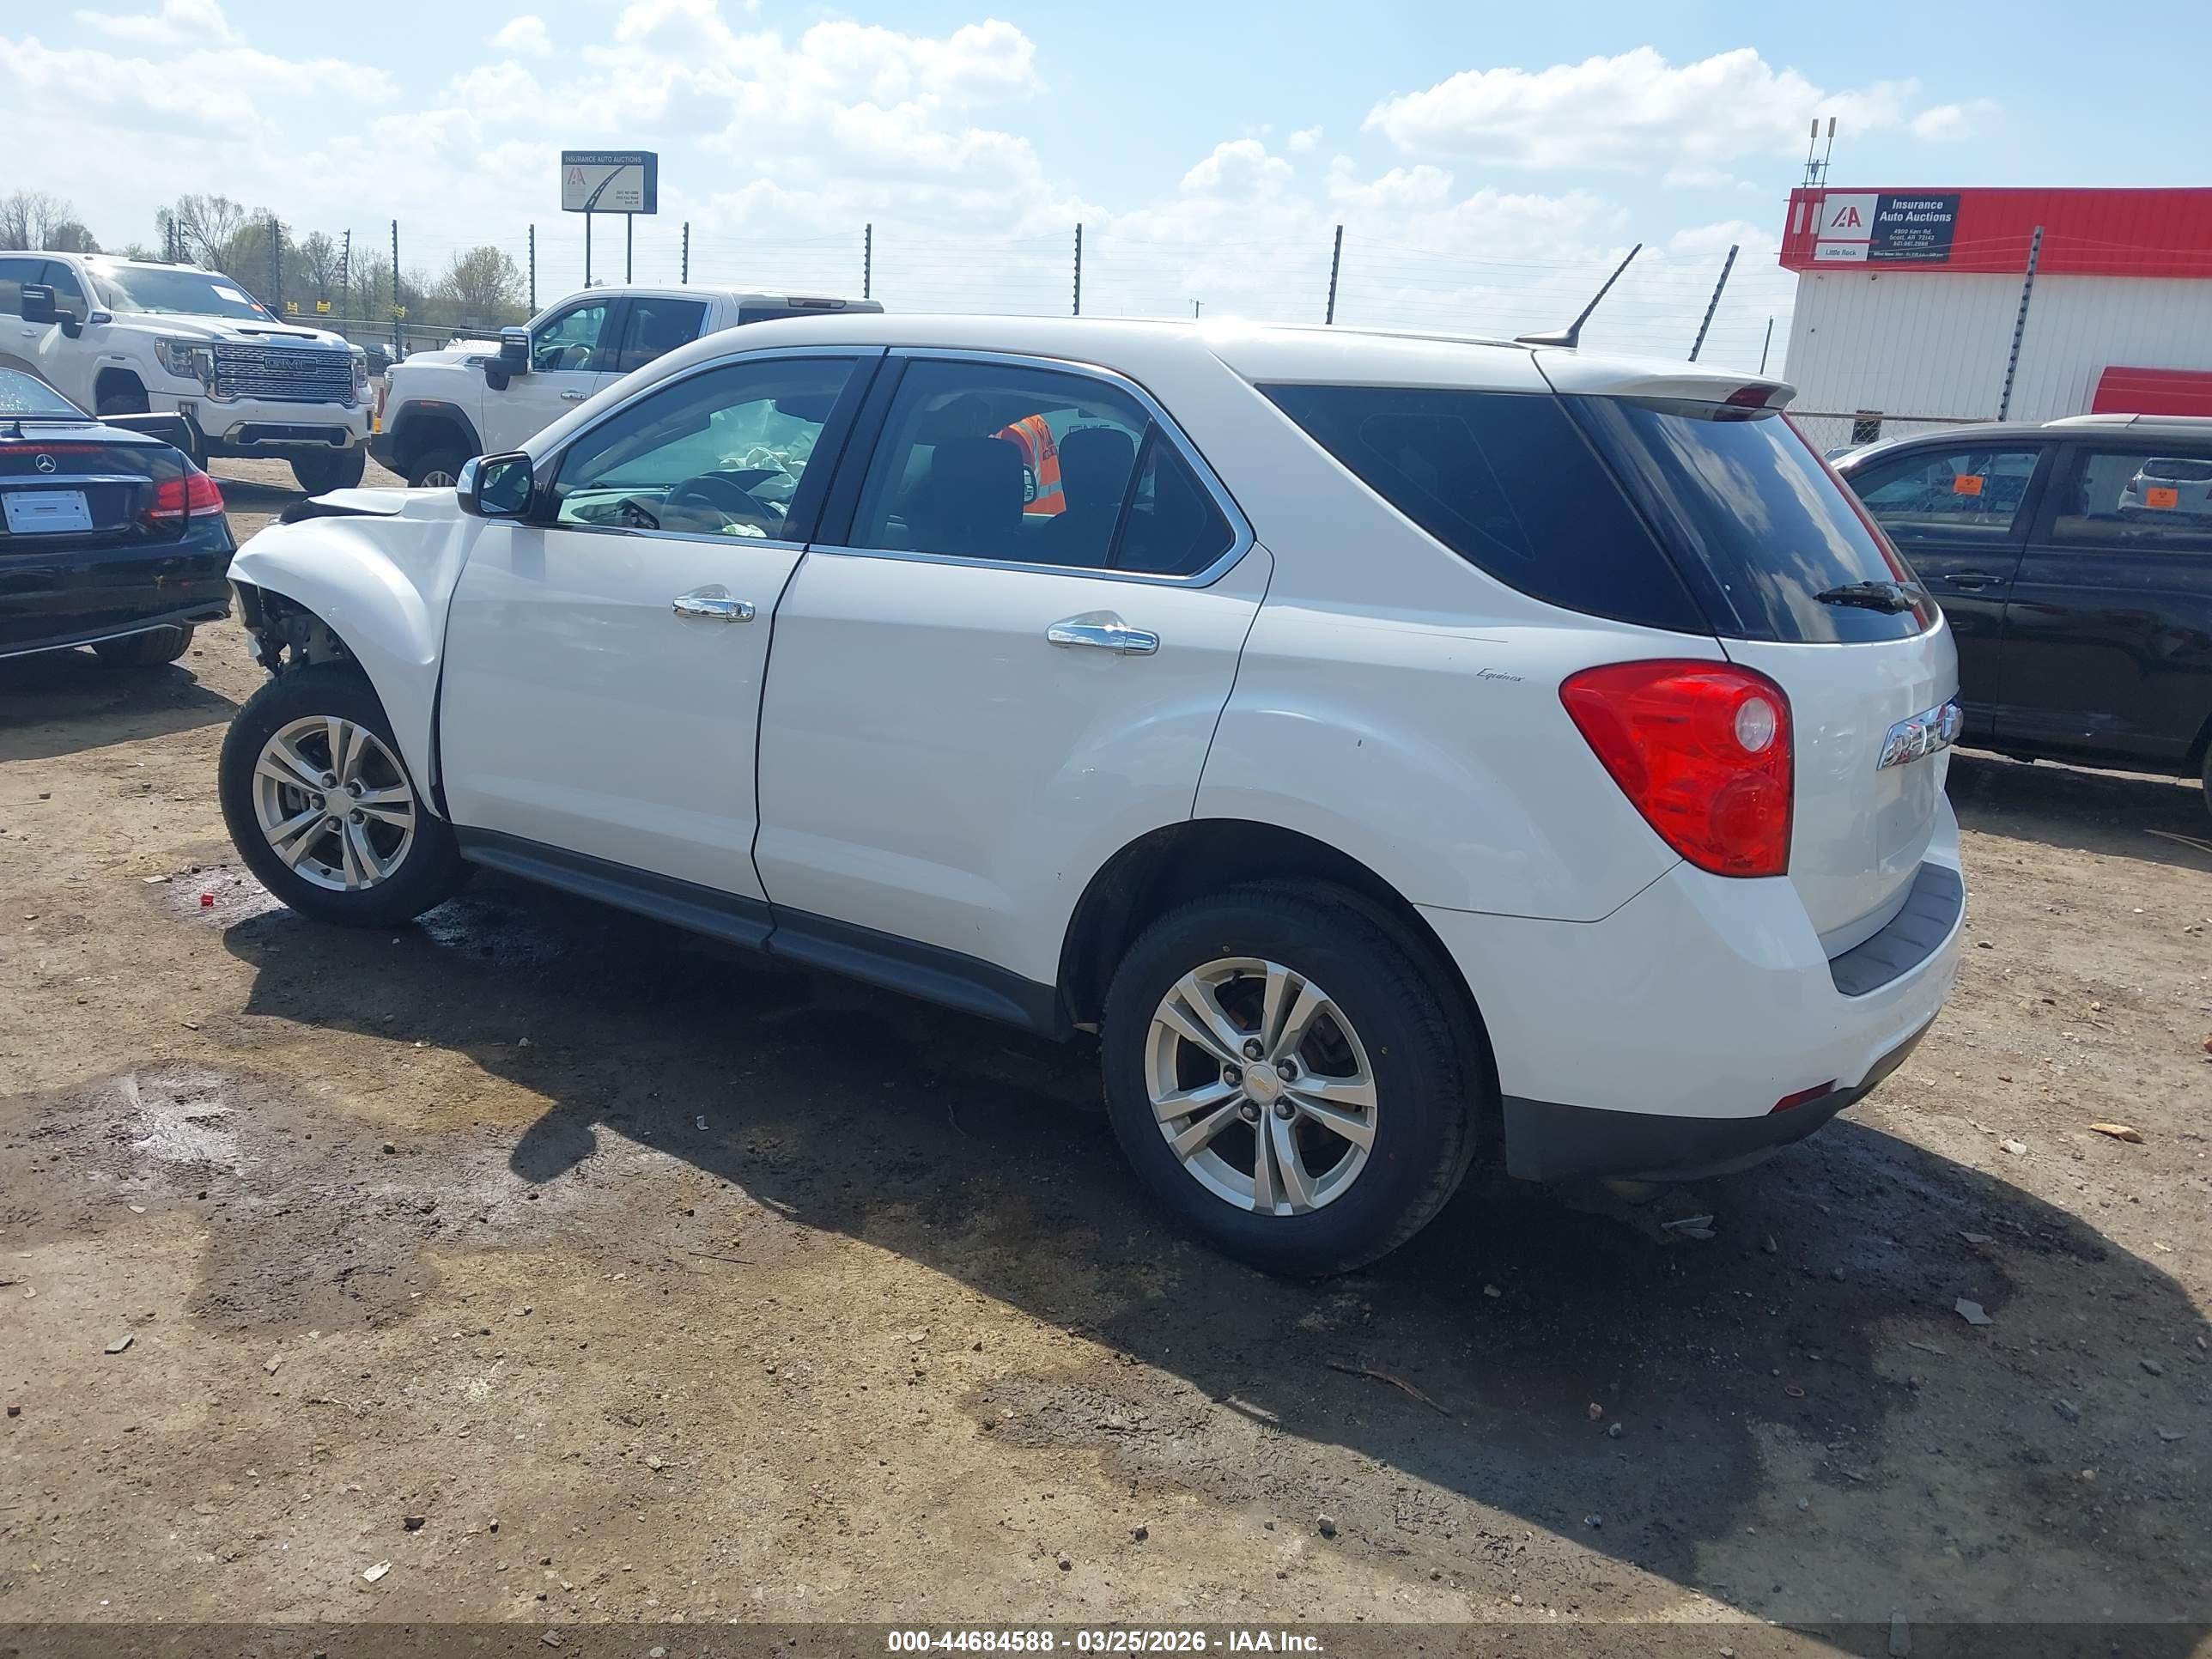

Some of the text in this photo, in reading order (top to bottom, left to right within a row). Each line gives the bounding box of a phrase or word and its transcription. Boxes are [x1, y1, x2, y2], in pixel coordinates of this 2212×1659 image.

[565, 155, 642, 164] INSURANCE AUTO AUCTIONS
[1892, 198, 1944, 210] Insurance
[1879, 211, 1952, 222] Auto Auctions
[265, 357, 316, 370] GMC
[1476, 667, 1525, 682] Equinox
